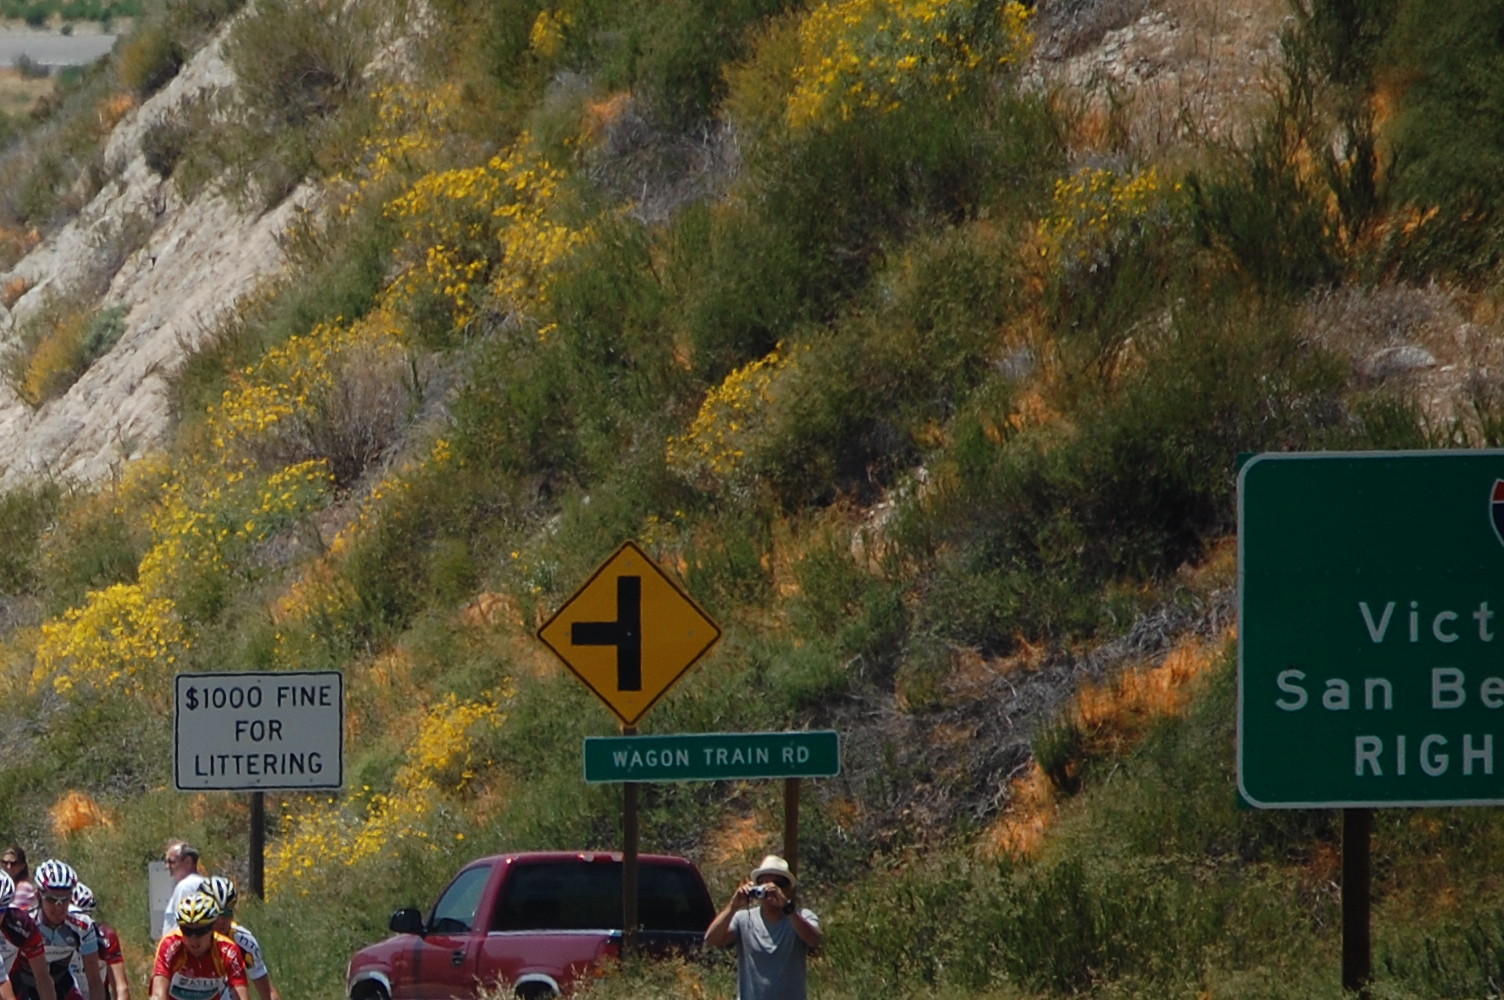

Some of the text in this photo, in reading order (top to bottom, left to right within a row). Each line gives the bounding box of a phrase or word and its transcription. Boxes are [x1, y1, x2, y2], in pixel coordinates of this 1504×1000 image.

[185, 685, 333, 711] $1000 FINE
[1275, 668, 1394, 712] San
[234, 719, 284, 742] FOR
[194, 752, 323, 777] LITTERING
[612, 745, 811, 768] WAGON TRAIN RD
